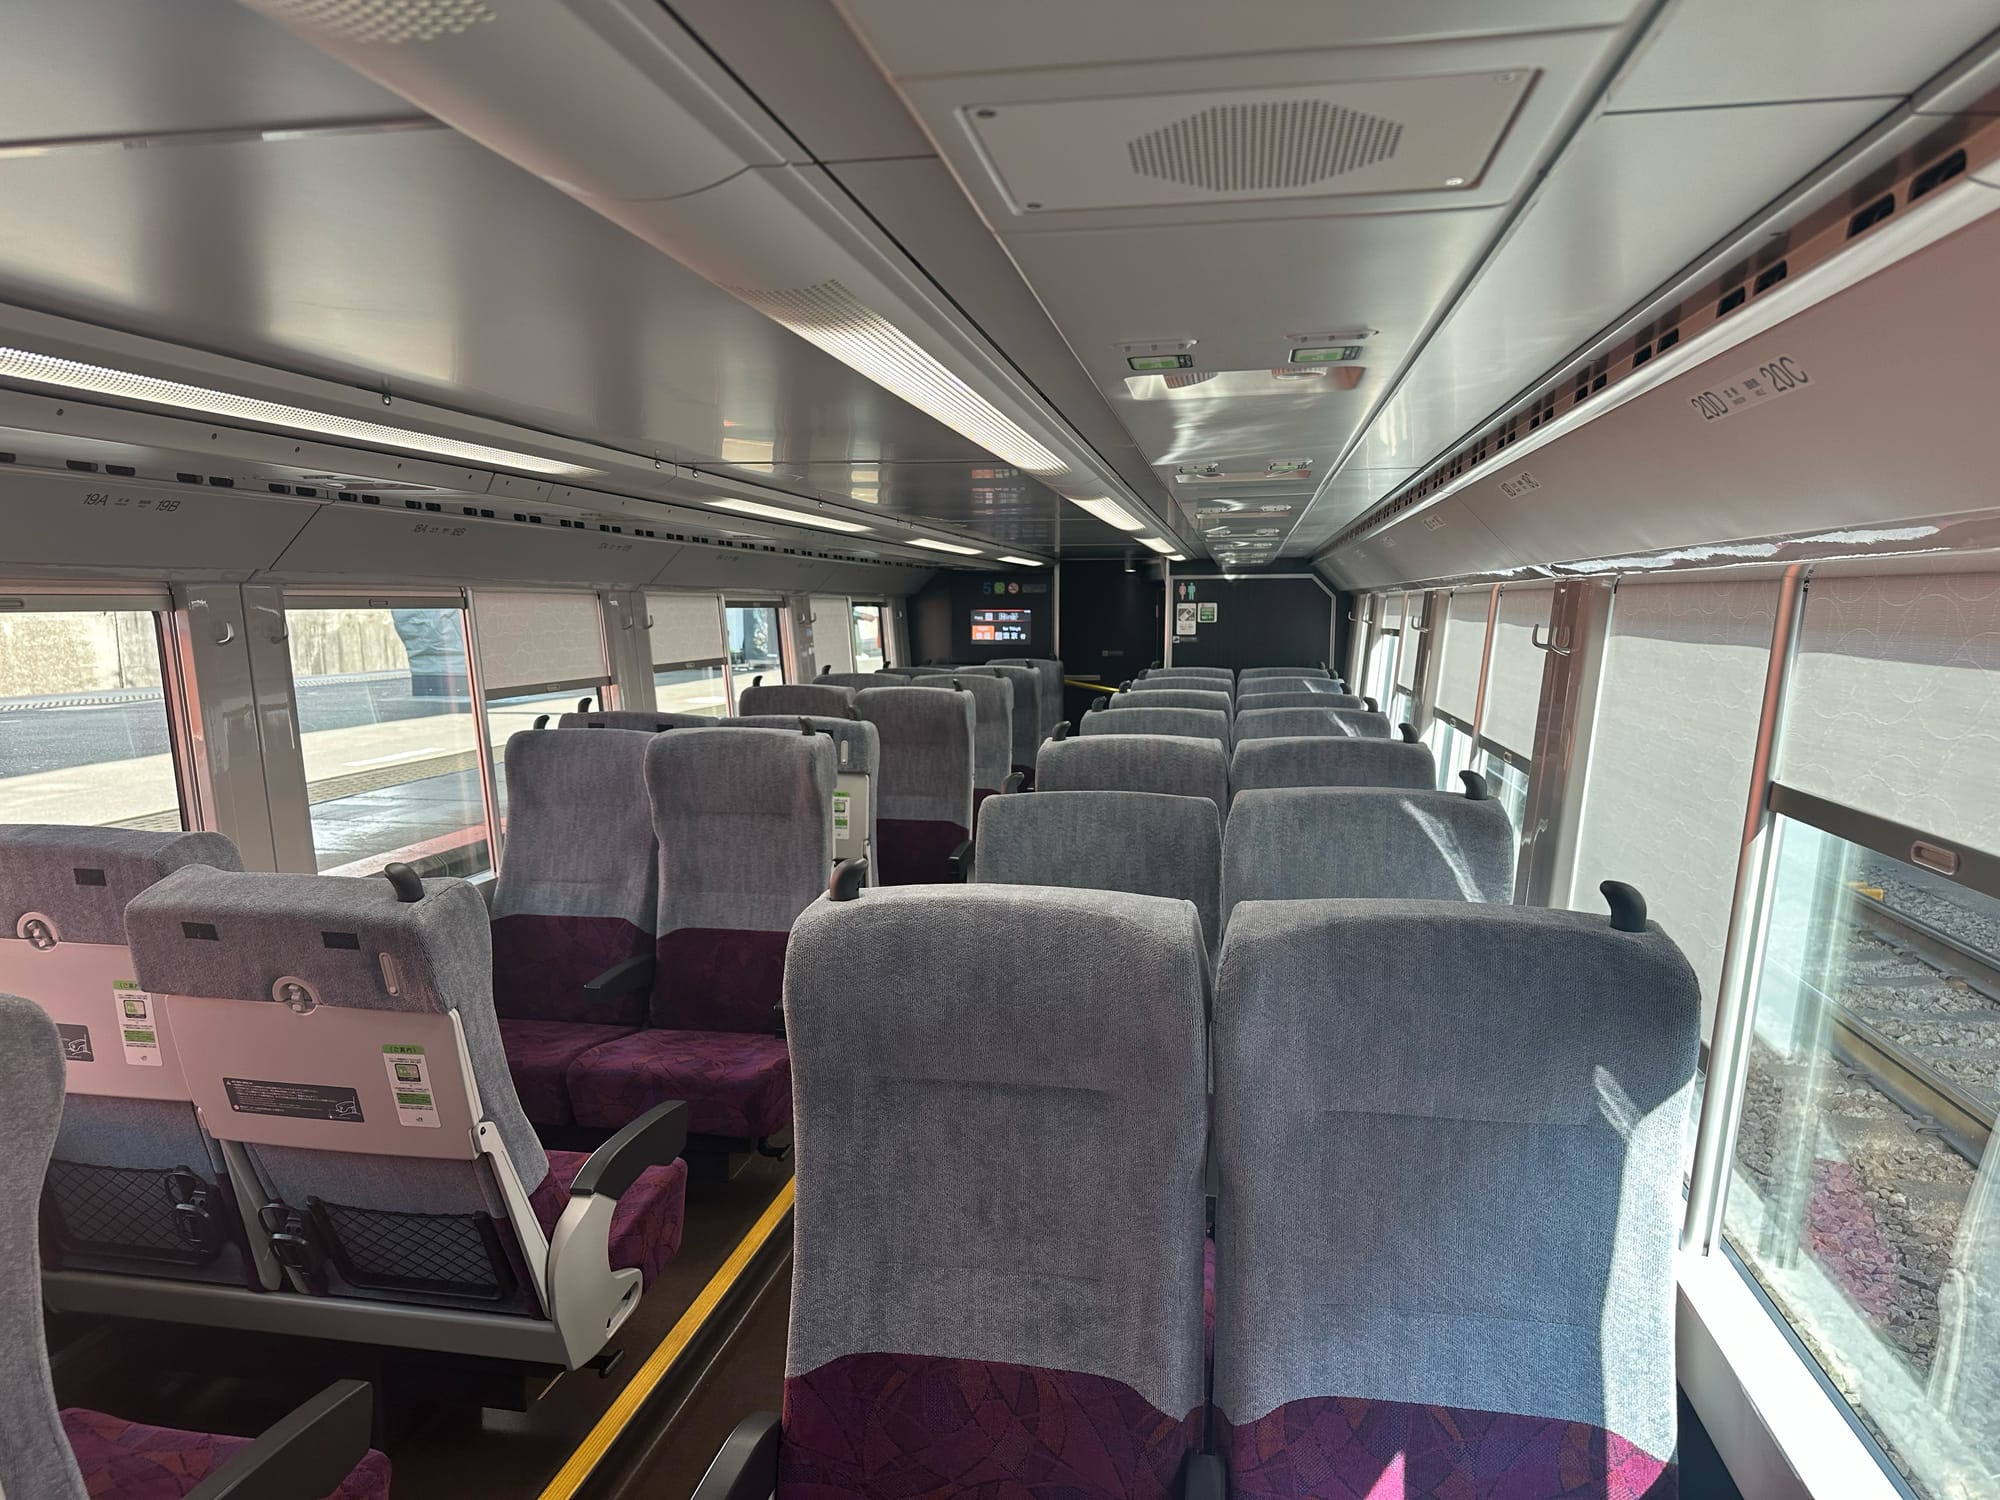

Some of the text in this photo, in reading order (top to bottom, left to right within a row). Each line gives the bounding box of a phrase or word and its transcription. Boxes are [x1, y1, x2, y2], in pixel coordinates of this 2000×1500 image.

[1691, 391, 1729, 420] 20D
[1759, 356, 1809, 392] 20C
[82, 492, 110, 506] 19A
[155, 499, 181, 512] 19B
